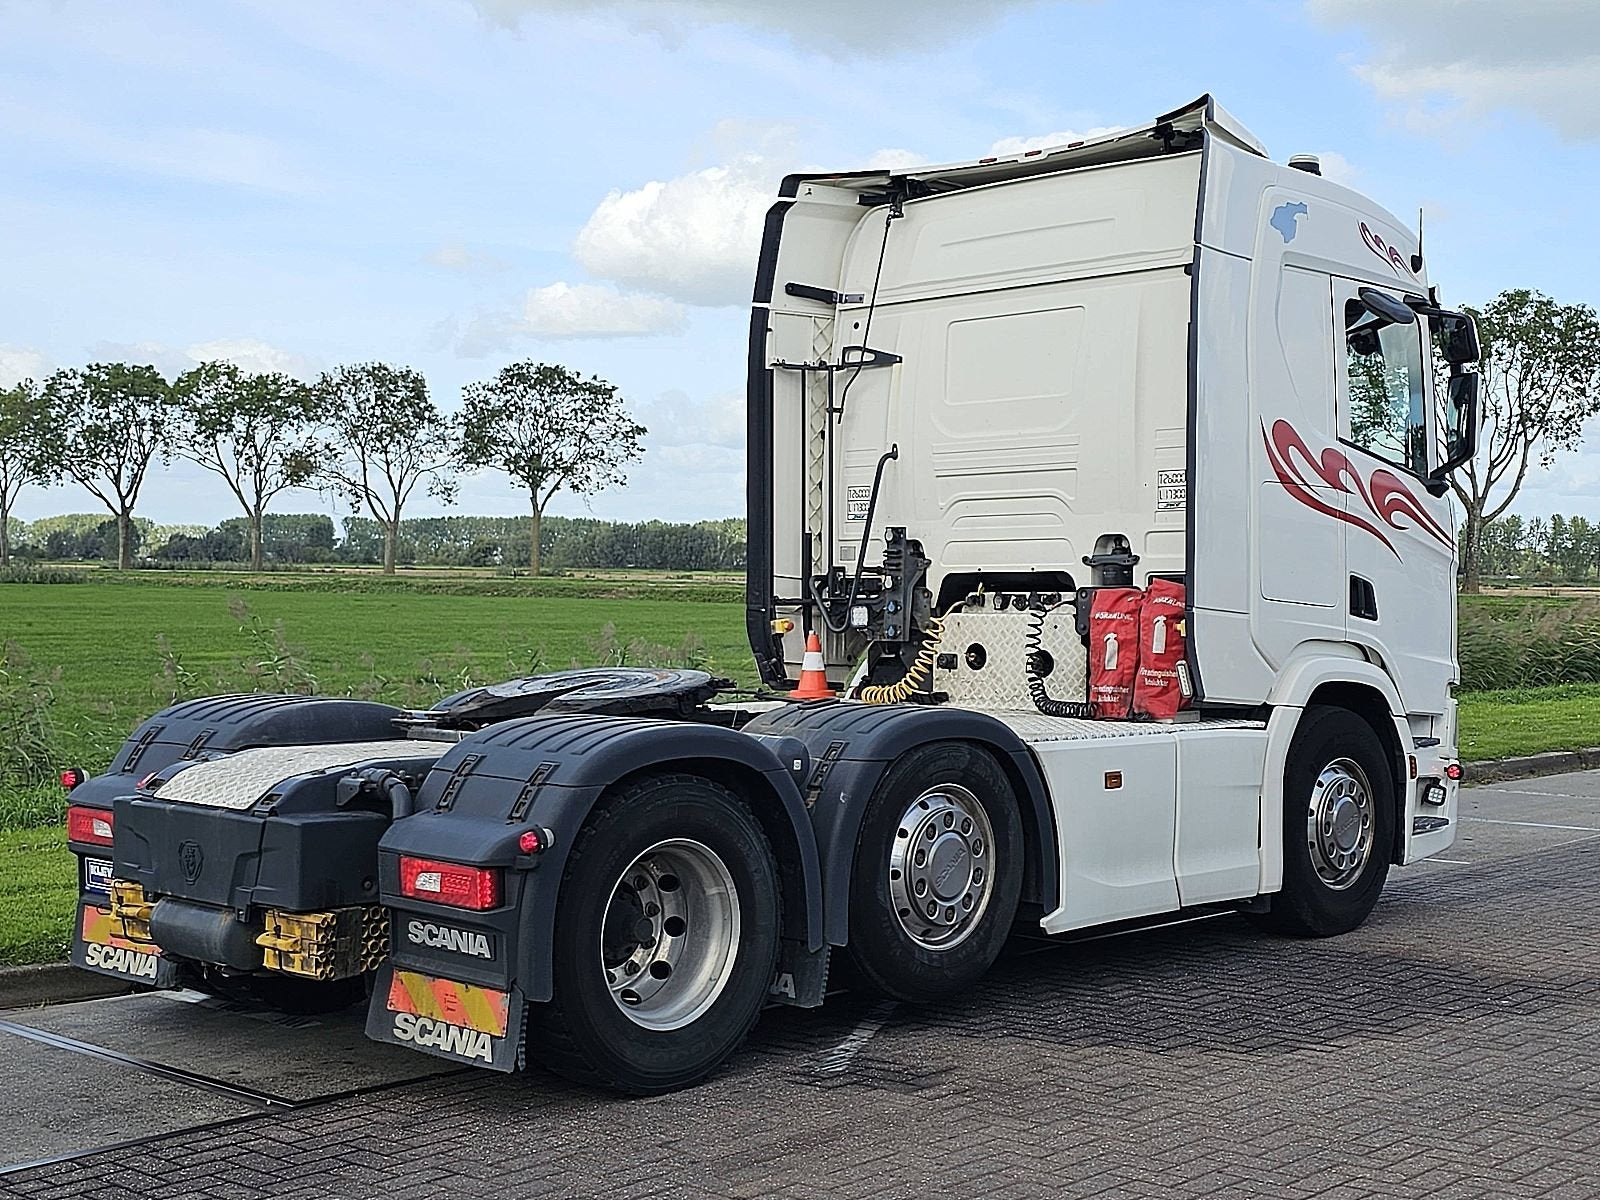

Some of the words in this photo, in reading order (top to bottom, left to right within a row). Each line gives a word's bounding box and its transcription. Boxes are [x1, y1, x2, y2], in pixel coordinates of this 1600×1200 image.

[90, 864, 114, 879] KLEY
[408, 920, 491, 959] SCANIA
[85, 942, 158, 979] SCANIA
[393, 1013, 493, 1063] SCANIA
